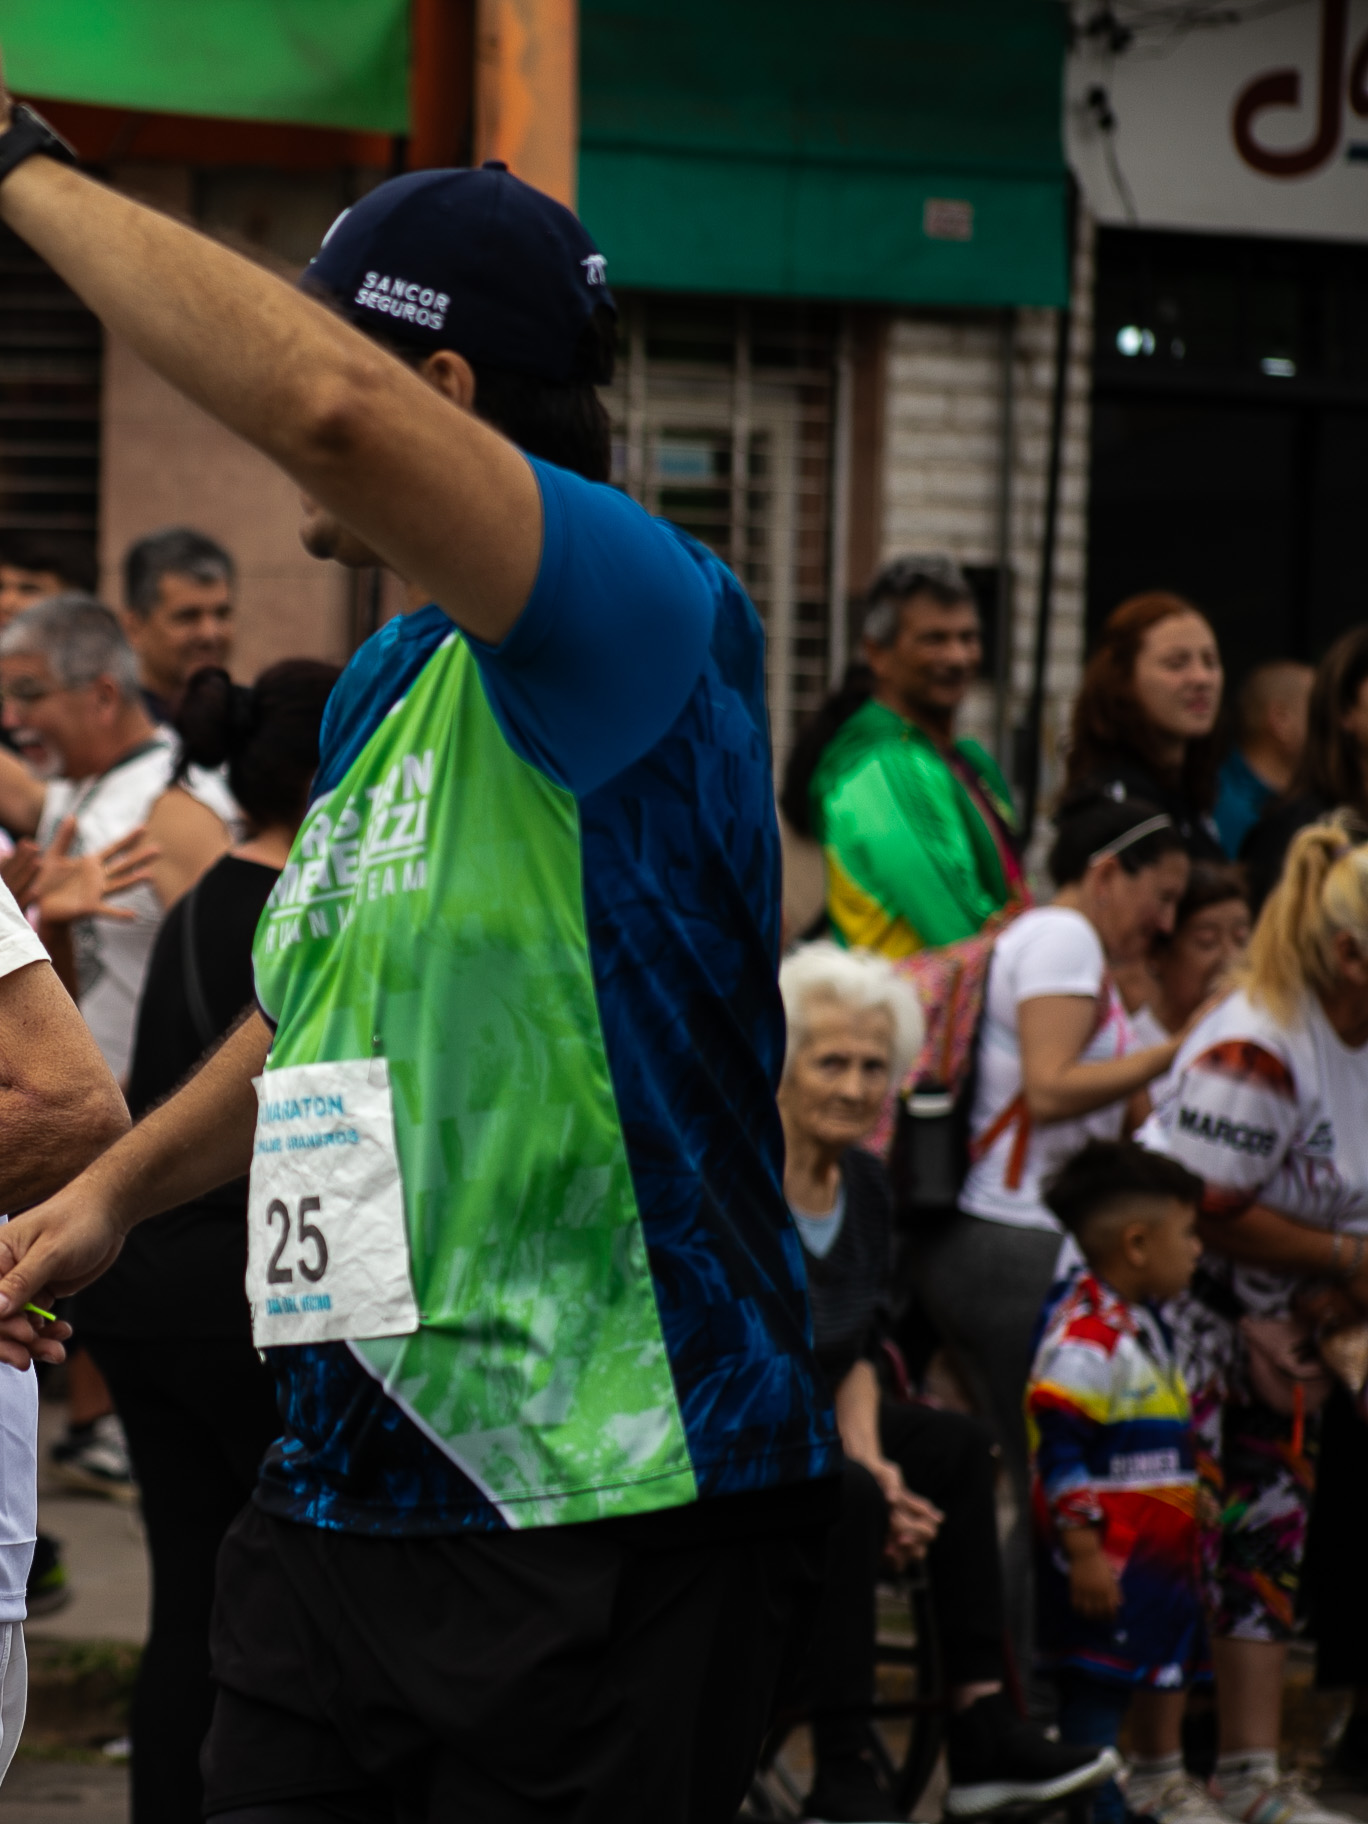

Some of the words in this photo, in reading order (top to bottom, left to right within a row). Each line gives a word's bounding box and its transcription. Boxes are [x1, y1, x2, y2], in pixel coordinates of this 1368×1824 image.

[1230, 0, 1368, 182] J
[355, 288, 444, 330] SEGUROS
[363, 271, 451, 312] SANCOR
[1179, 1107, 1278, 1156] MARCOS
[266, 1195, 328, 1284] 25
